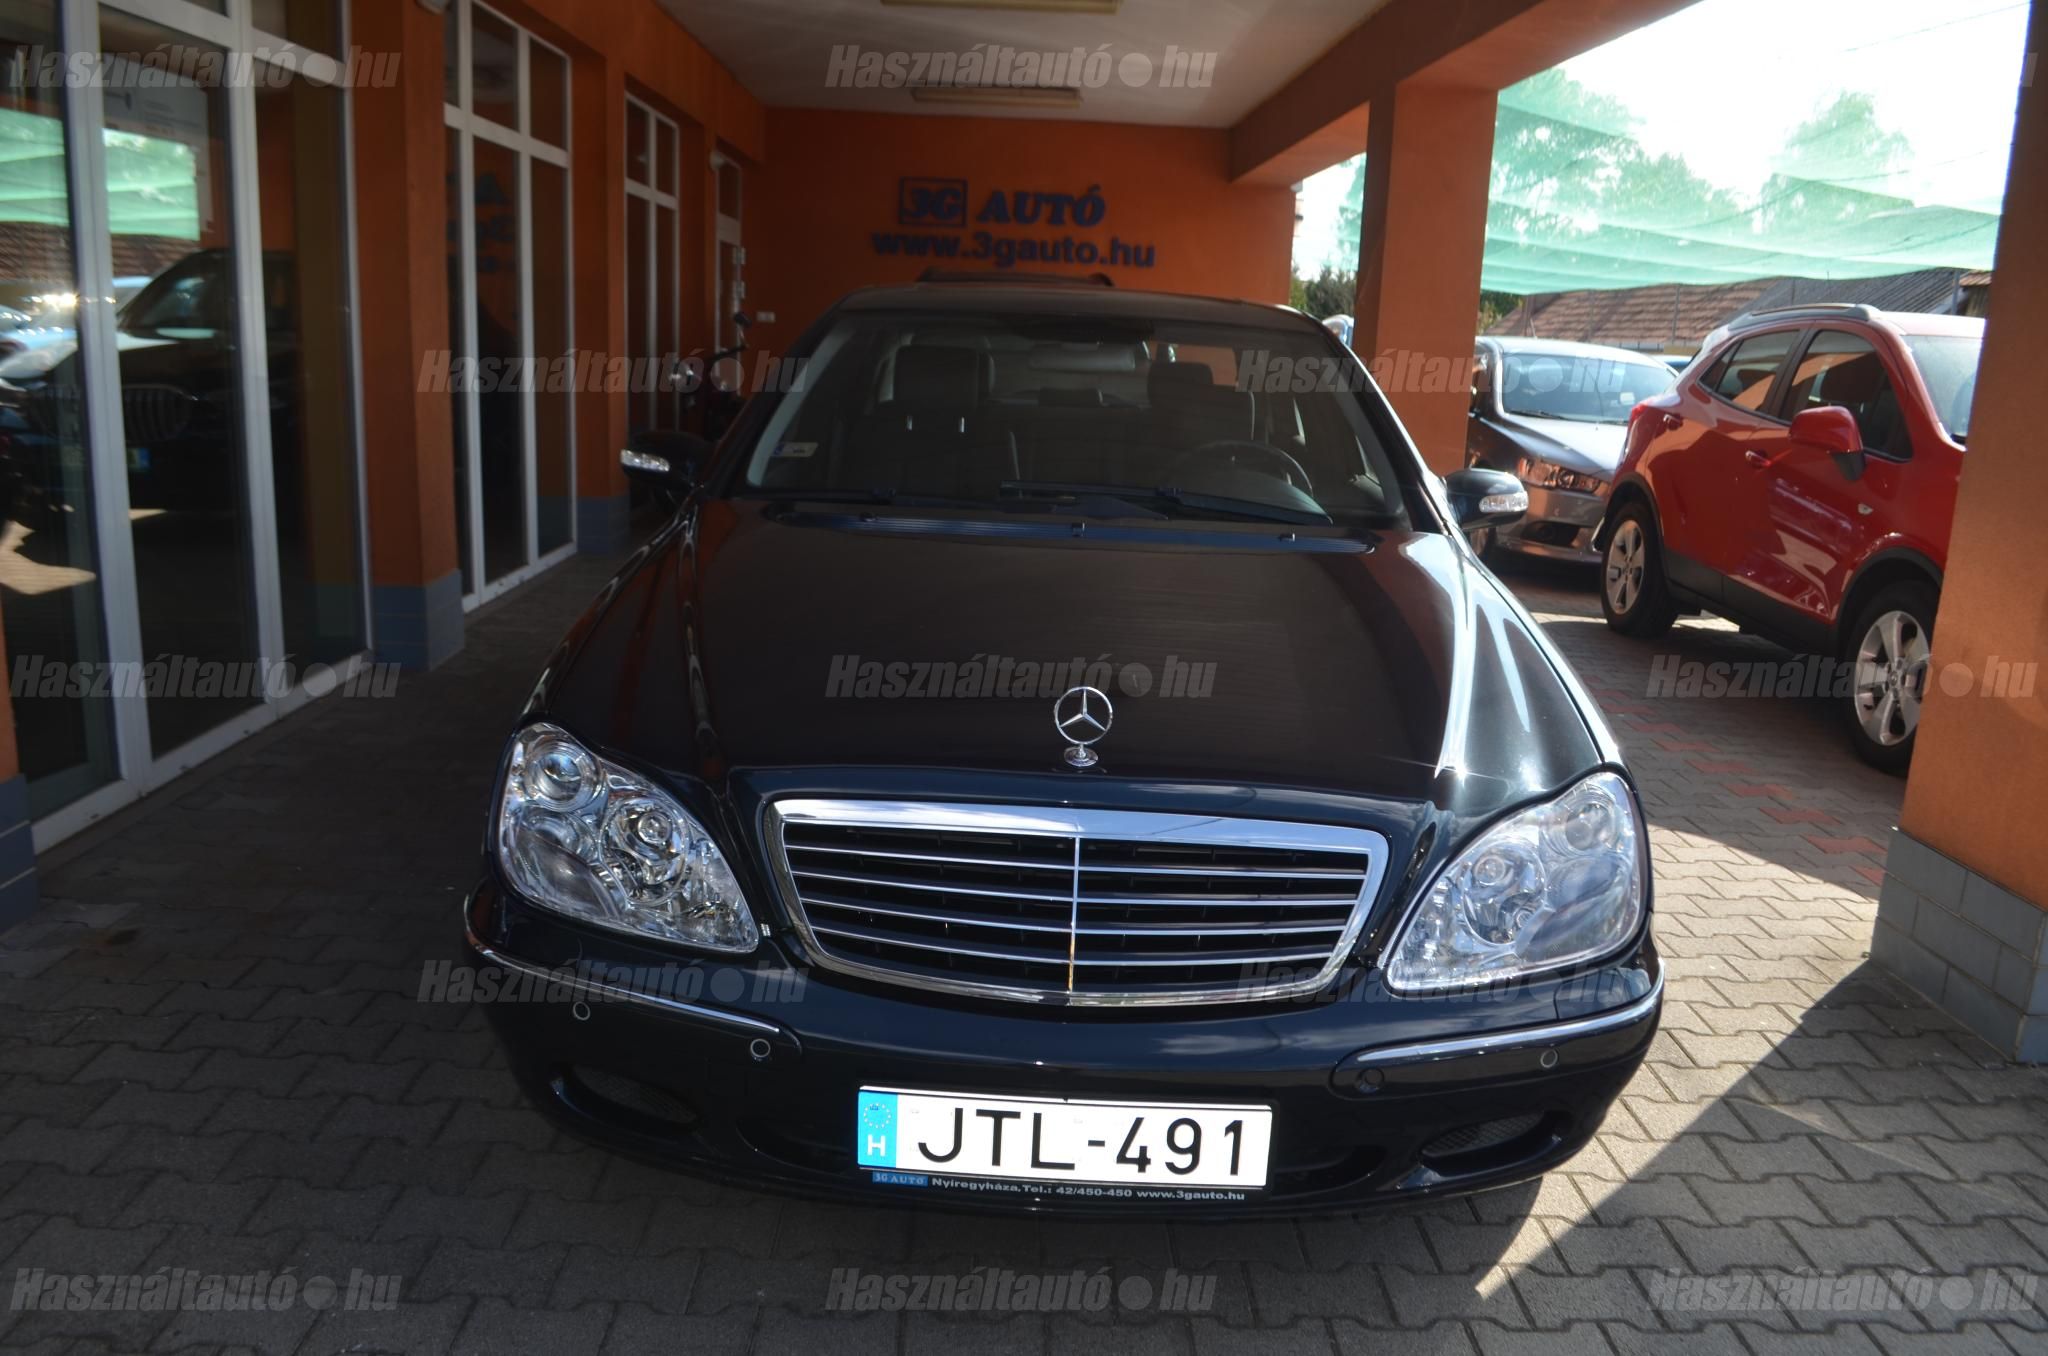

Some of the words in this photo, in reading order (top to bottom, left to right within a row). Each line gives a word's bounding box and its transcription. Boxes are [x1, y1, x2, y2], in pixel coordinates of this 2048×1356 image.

[904, 187, 961, 219] 3G
[976, 184, 1106, 227] AUTÓ
[871, 231, 1155, 267] www.3gauto.hu
[867, 1134, 886, 1157] H
[917, 1107, 1243, 1176] JTL-491
[1055, 1186, 1133, 1198] 42/450-450
[1137, 1189, 1245, 1200] www.3gauto.hu
